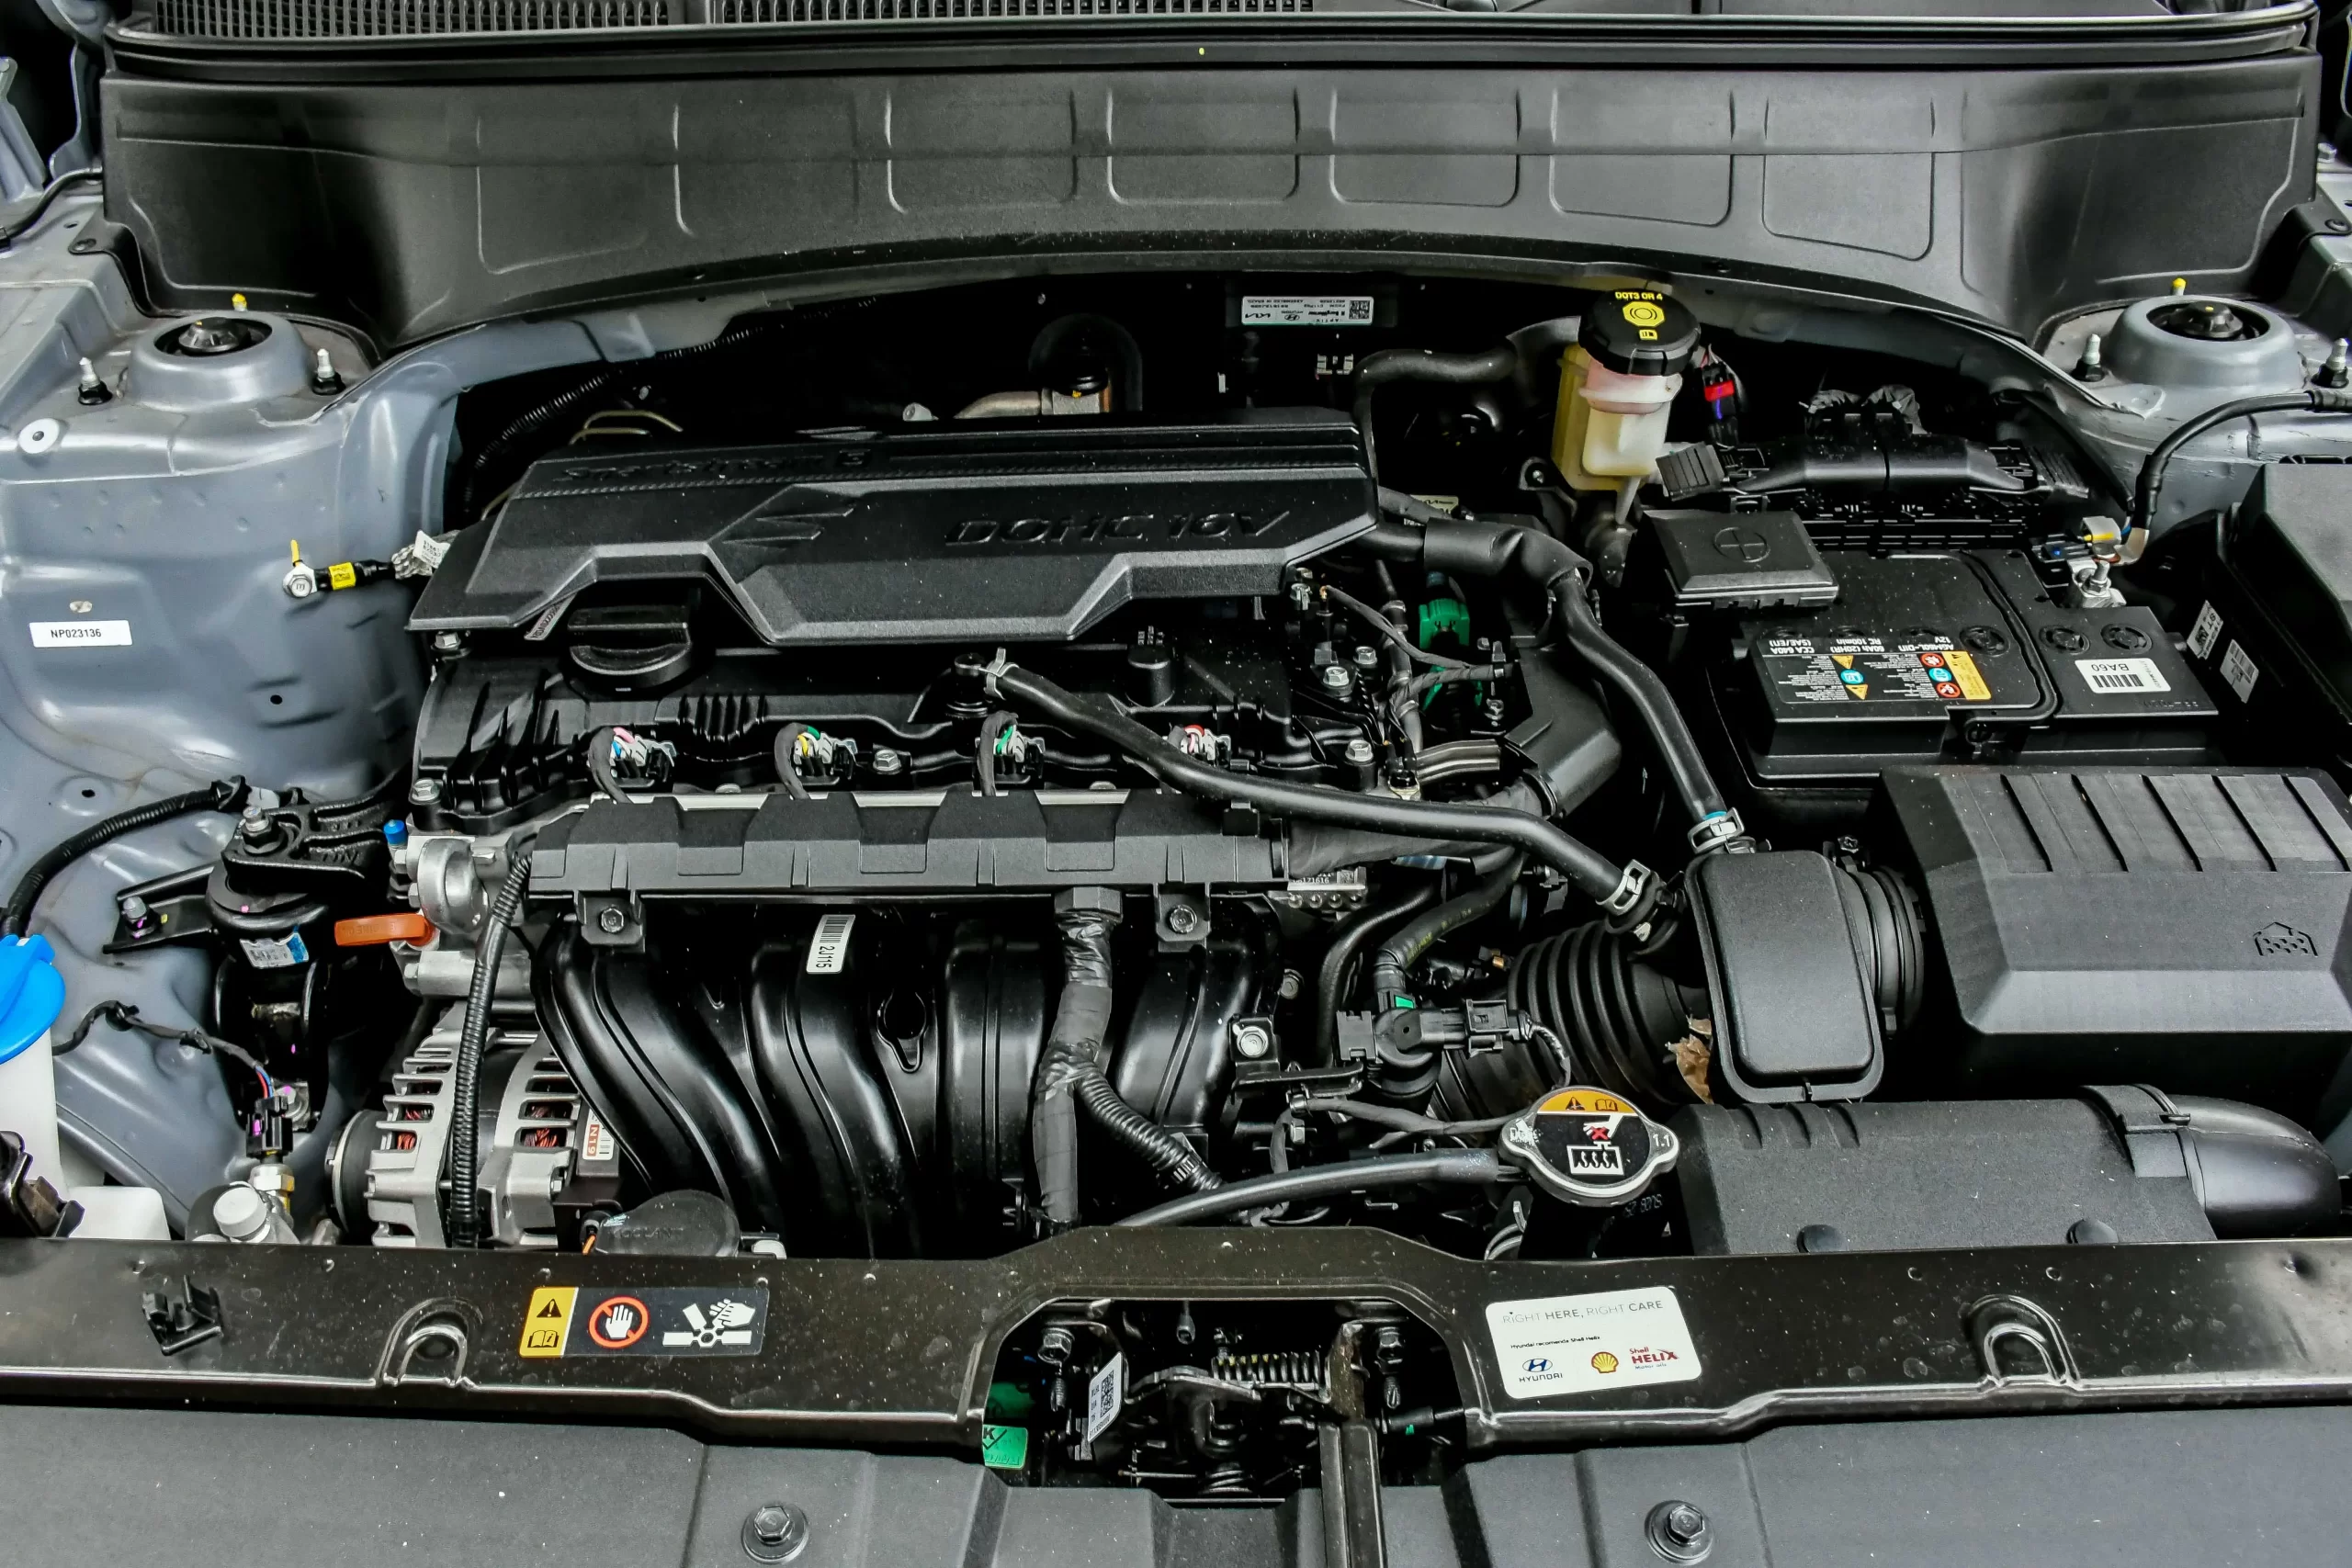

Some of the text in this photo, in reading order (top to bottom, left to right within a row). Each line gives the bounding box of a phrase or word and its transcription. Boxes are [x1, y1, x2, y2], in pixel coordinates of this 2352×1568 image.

[1614, 291, 1640, 300] DOT3
[1641, 292, 1655, 300] OR
[945, 511, 1290, 546] DOHC 16V
[51, 628, 102, 638] NP023136
[1868, 637, 1882, 646] RC
[1934, 635, 1951, 644] 12V
[1770, 646, 1815, 655] CCA 640A
[1829, 644, 1885, 653] 60Ah (20HR)
[2090, 663, 2130, 671] BA60
[816, 945, 835, 968] 2J115
[588, 1126, 598, 1155] N19
[1652, 1133, 1671, 1147] 1.1
[1501, 1300, 1664, 1325] RIGHT HERE, RIGHT CARE
[1629, 1346, 1649, 1355] Shell
[1631, 1350, 1679, 1364] HELIX
[1518, 1372, 1564, 1383] HYUNDAI
